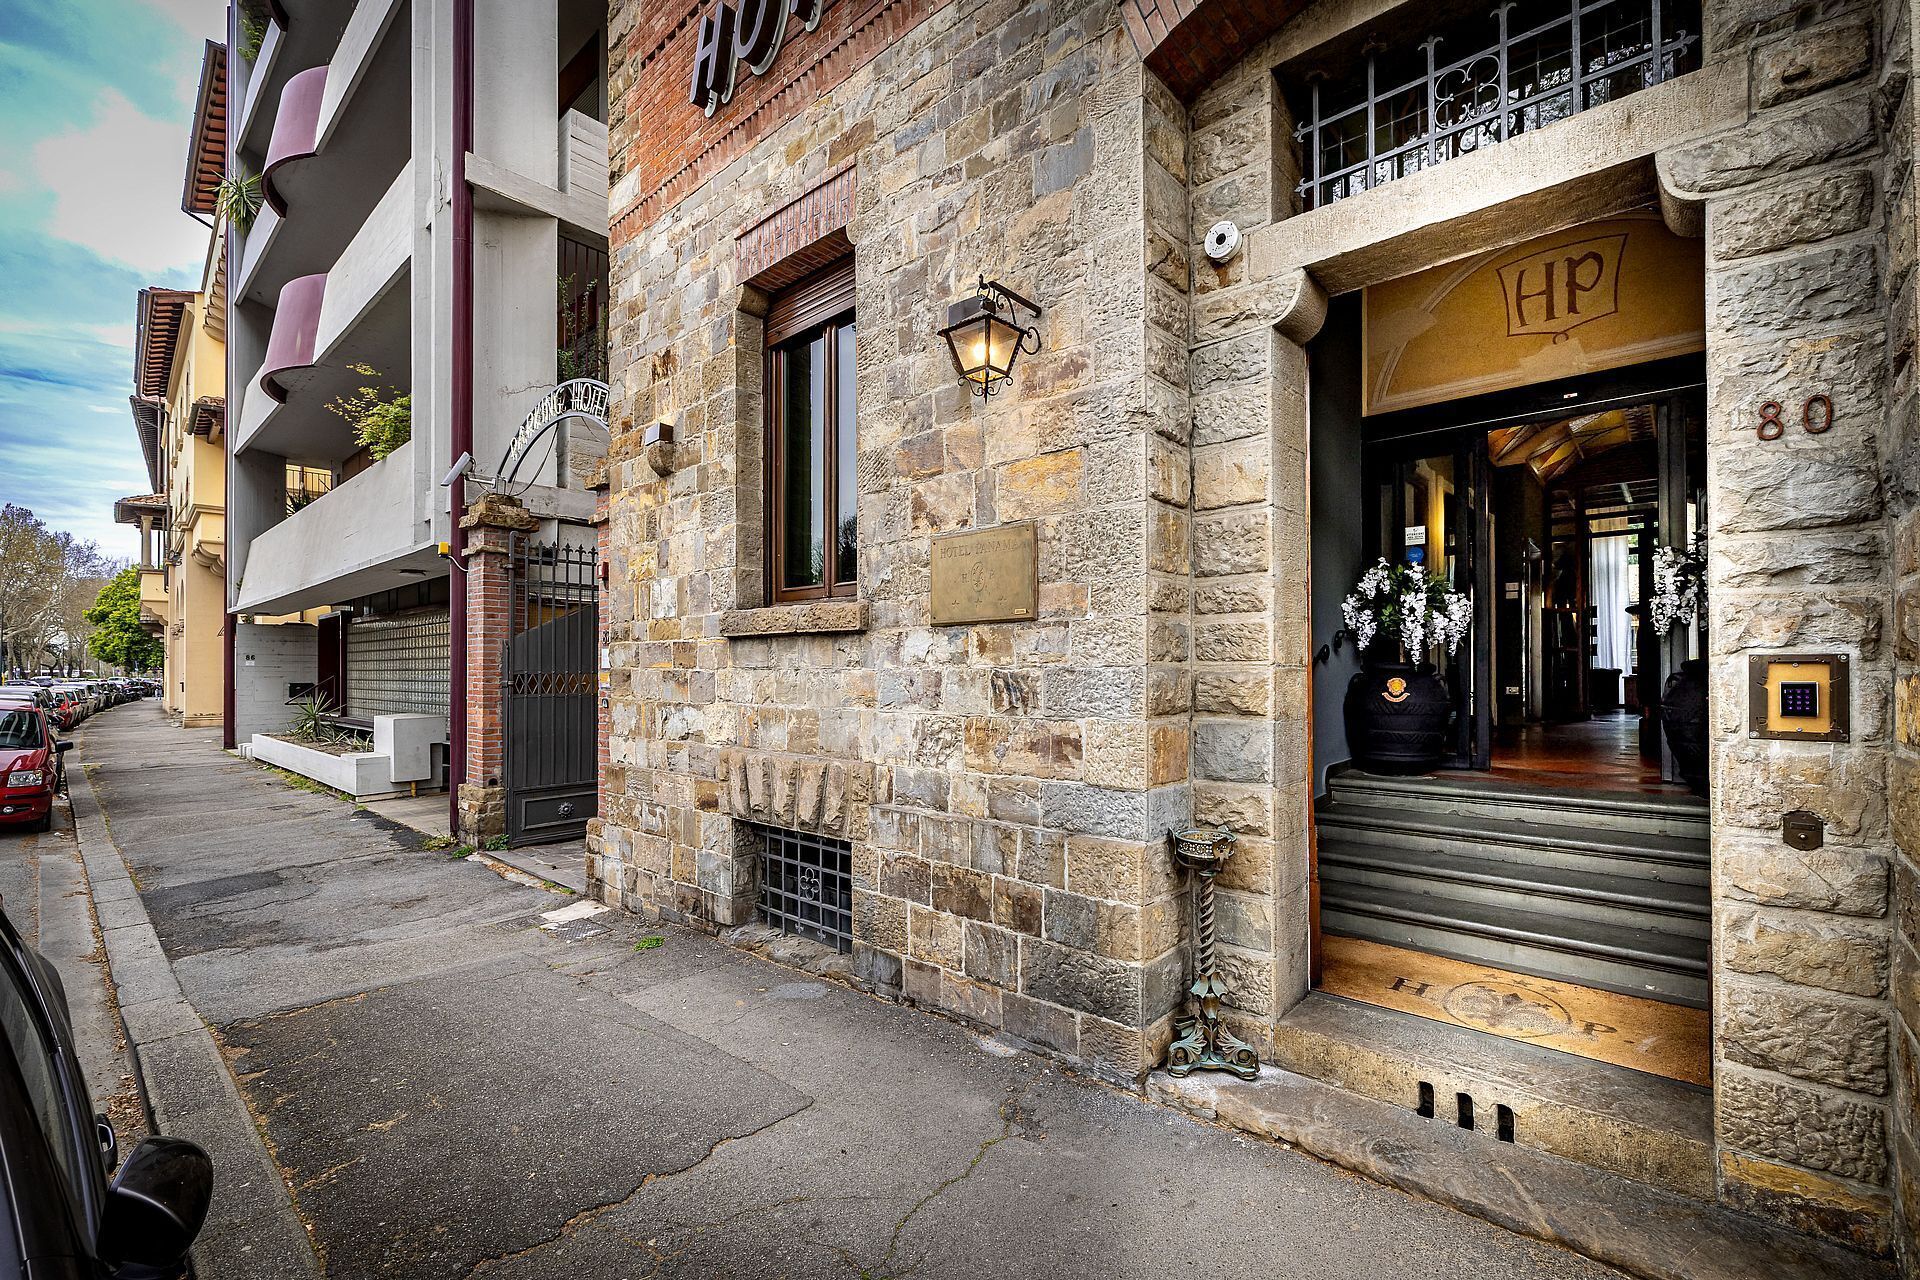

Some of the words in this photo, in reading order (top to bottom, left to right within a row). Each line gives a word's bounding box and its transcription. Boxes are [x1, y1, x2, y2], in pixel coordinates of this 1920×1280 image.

[1515, 250, 1605, 328] HP
[510, 387, 566, 461] PARKING
[1756, 393, 1833, 441] 80
[940, 544, 971, 559] HOTEL
[1385, 976, 1435, 998] H
[1579, 1019, 1618, 1042] P
